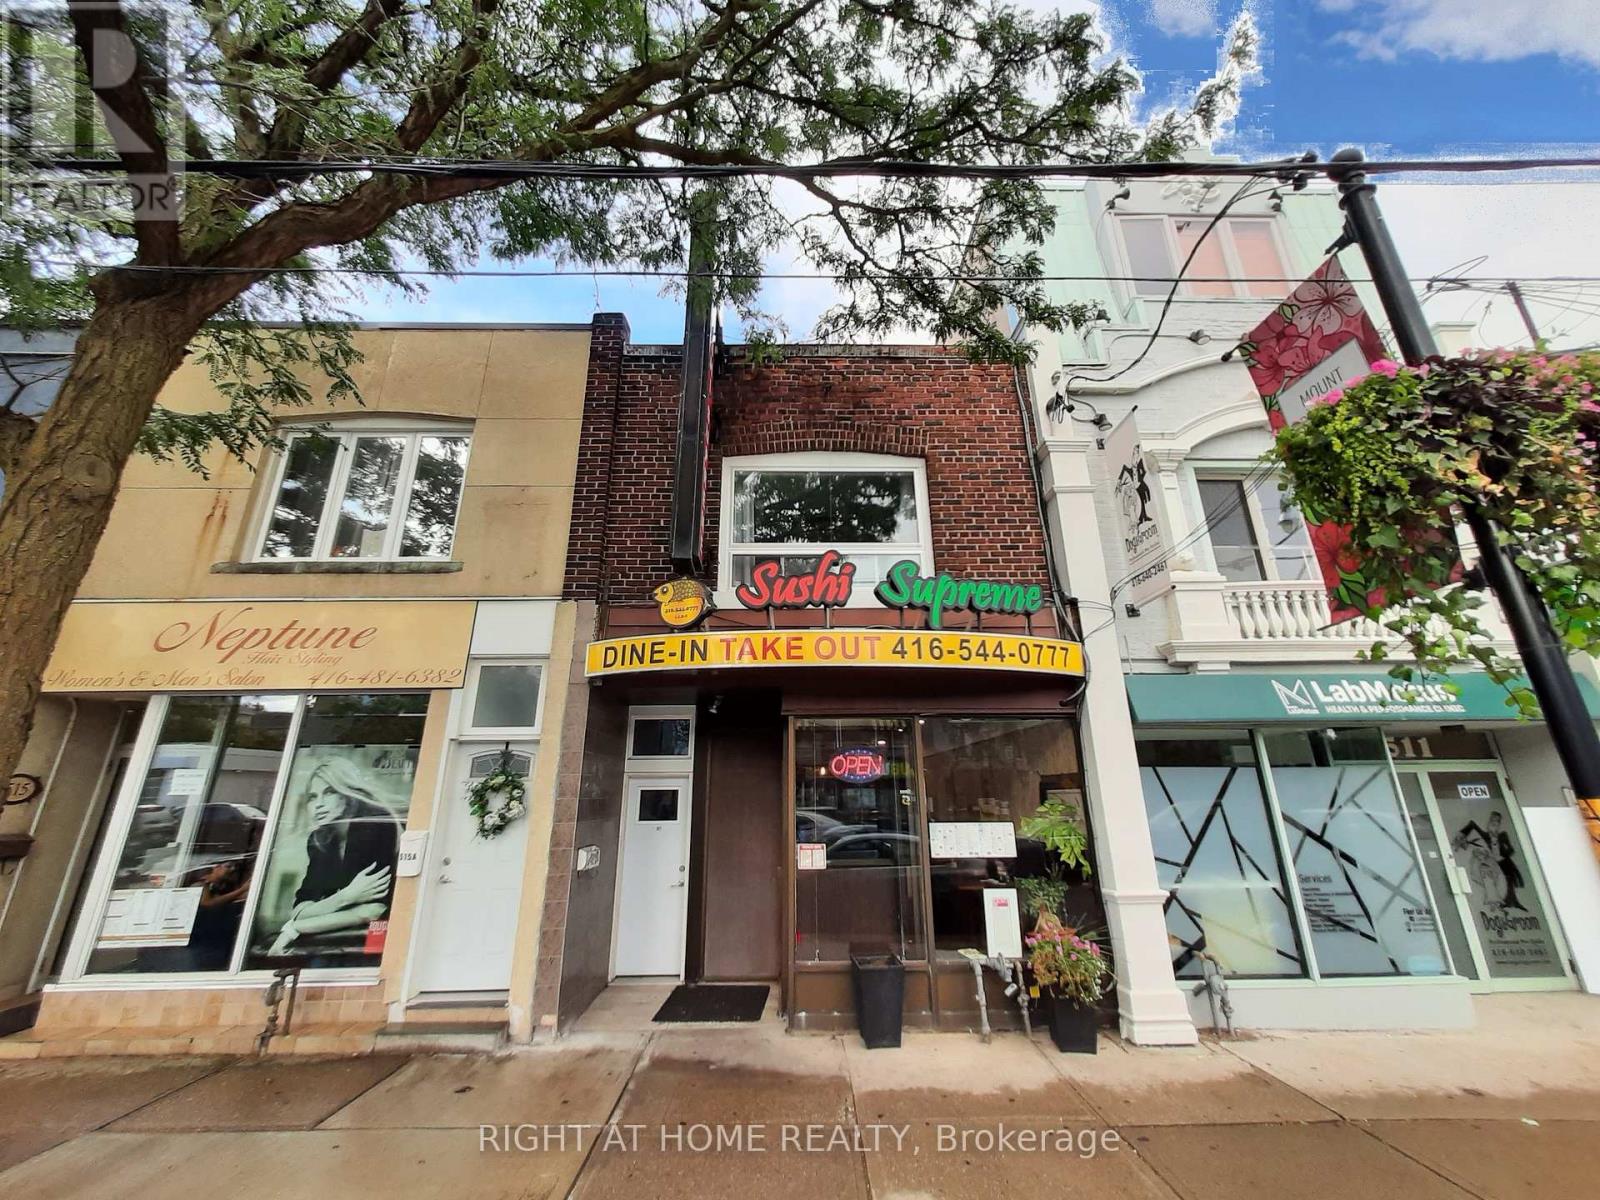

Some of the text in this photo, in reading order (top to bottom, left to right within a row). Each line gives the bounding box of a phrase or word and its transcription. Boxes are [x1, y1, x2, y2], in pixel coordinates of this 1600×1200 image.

[1300, 366, 1345, 408] MOUNT
[738, 551, 1042, 628] Sushi Supreme
[153, 607, 378, 663] Neptune
[243, 651, 343, 667] Hair Styling
[602, 636, 1071, 668] DINE-IN TAKE OUT 416-544-0777
[48, 667, 266, 688] Women's & Men's Salon
[307, 668, 463, 686] 416-481-6382
[1388, 737, 1434, 759] 511
[831, 754, 882, 775] OPEN
[9, 782, 31, 797] 15
[1461, 786, 1488, 797] OPEN
